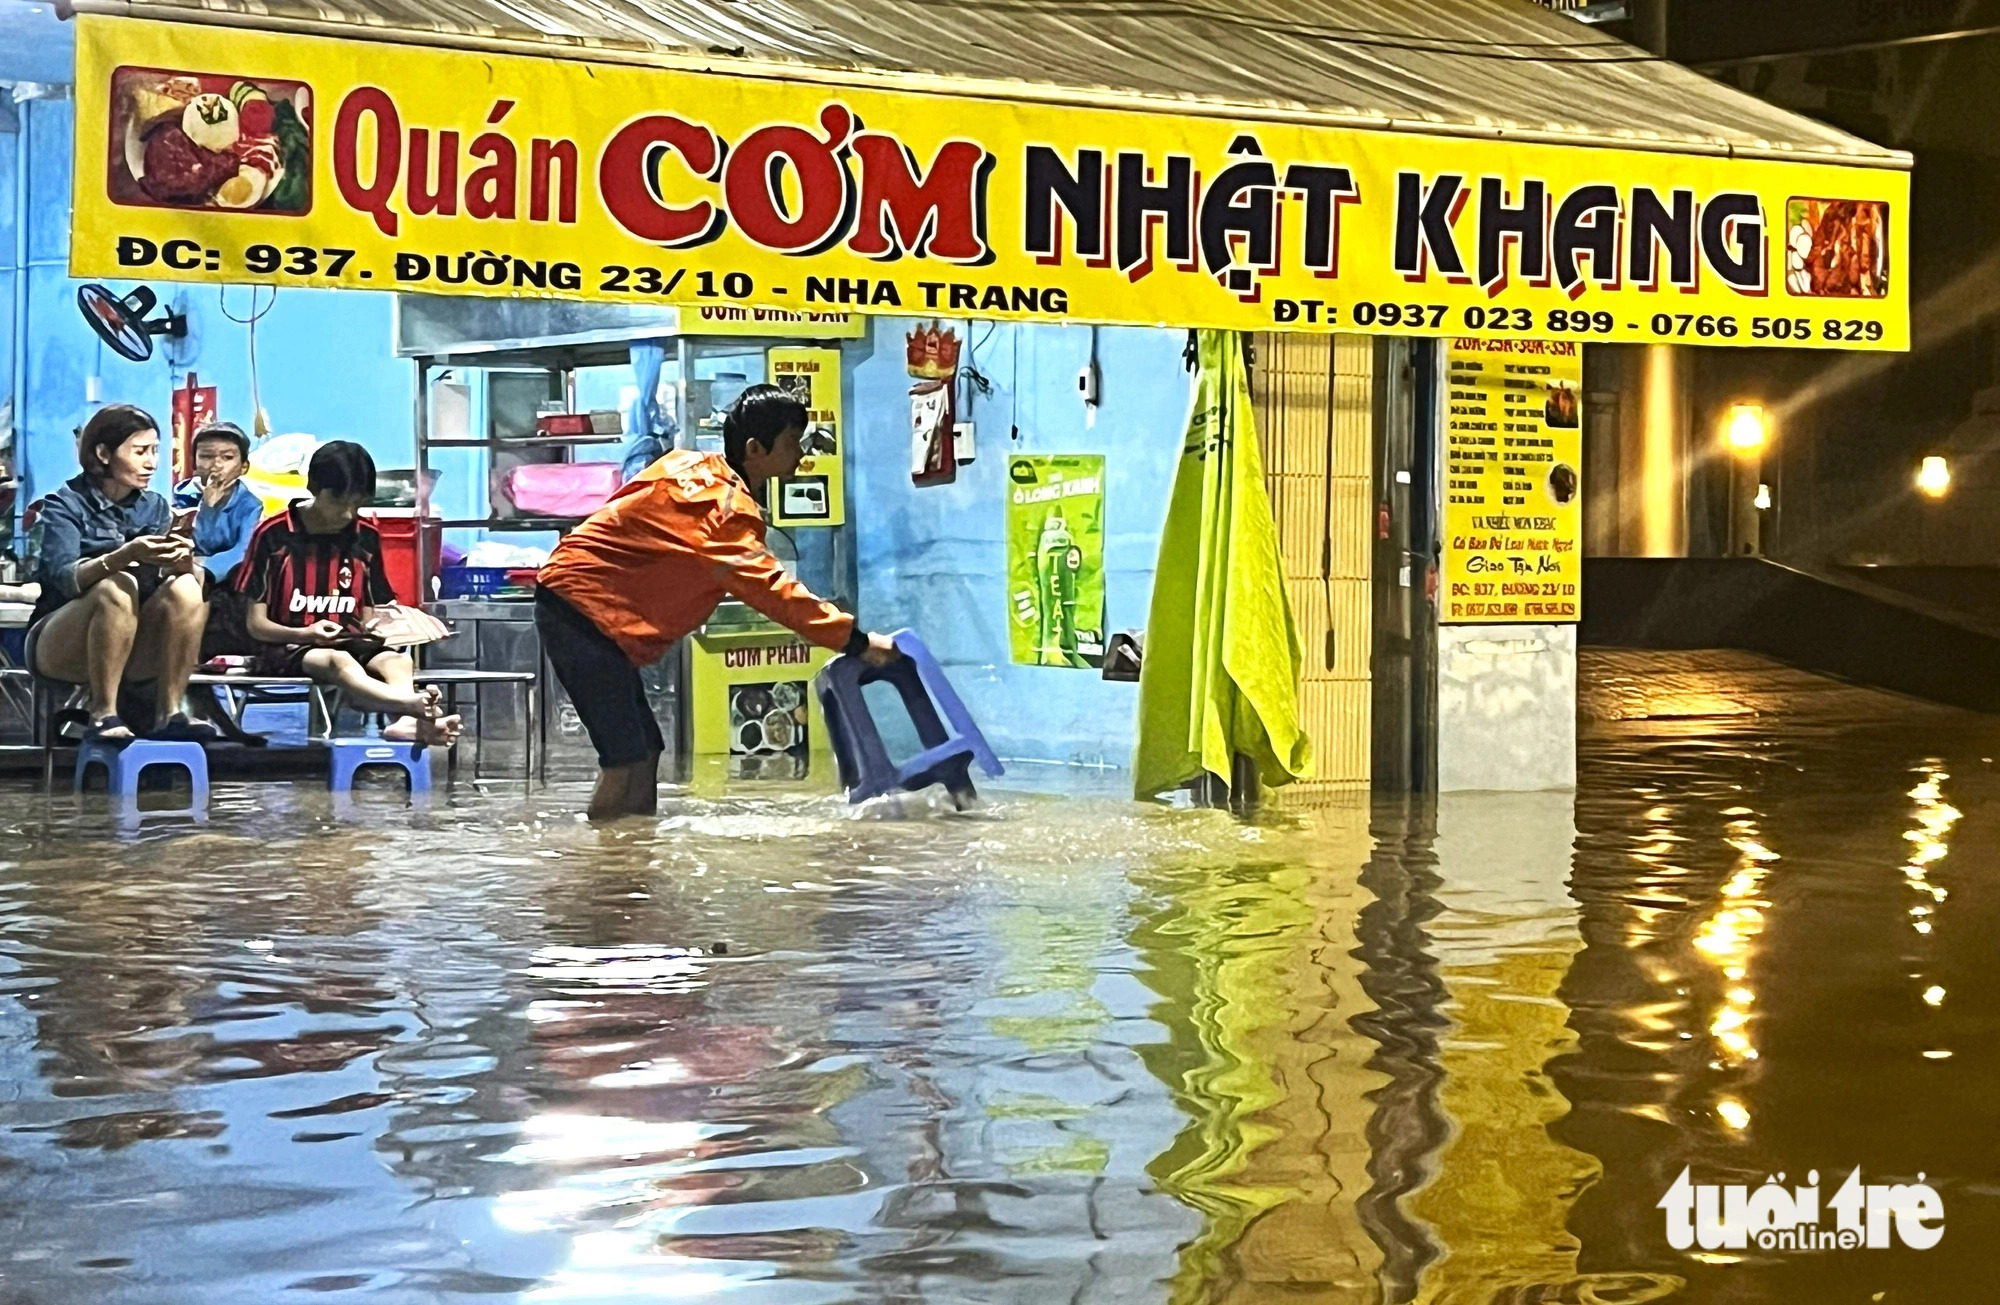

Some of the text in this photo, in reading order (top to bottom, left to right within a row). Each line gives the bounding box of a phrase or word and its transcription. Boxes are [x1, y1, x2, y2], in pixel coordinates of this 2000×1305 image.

[333, 86, 1769, 302] Quán CƠM NHẬT KHANG
[116, 236, 221, 271] ĐC:
[245, 244, 373, 279] 937.
[394, 250, 581, 291] ĐƯỜNG
[599, 265, 754, 299] 23/10
[806, 276, 901, 307] NHA
[917, 281, 1068, 314] TRANG
[1273, 298, 1338, 324] ĐT:
[1352, 301, 1449, 328] 0937
[1463, 306, 1533, 331] 023
[1546, 309, 1614, 333] 899
[1650, 313, 1739, 338] 0766
[1751, 317, 1812, 340] 505
[1822, 319, 1884, 341] 829
[289, 588, 356, 613] bwin
